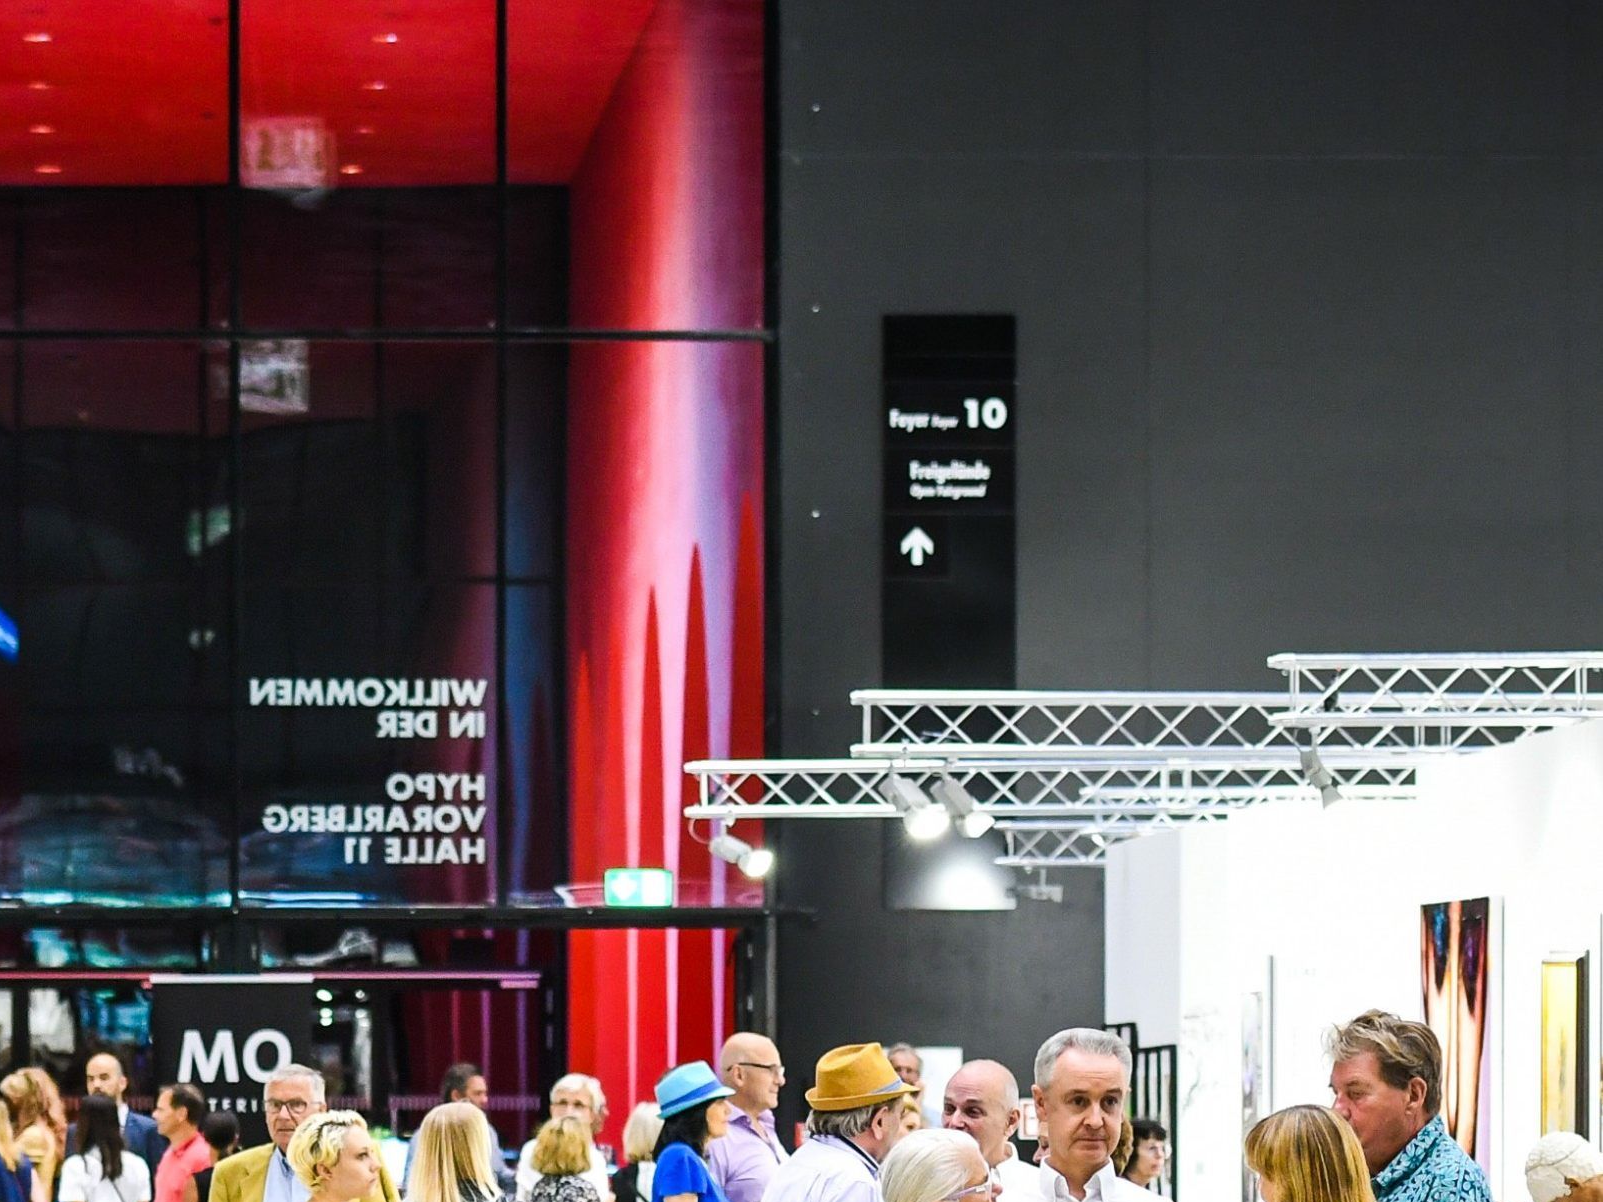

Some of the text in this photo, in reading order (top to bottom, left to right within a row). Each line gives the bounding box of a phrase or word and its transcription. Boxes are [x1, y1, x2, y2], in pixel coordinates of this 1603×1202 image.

[963, 397, 1008, 430] 10
[177, 1028, 293, 1084] MO
[207, 1097, 265, 1113] TERI
